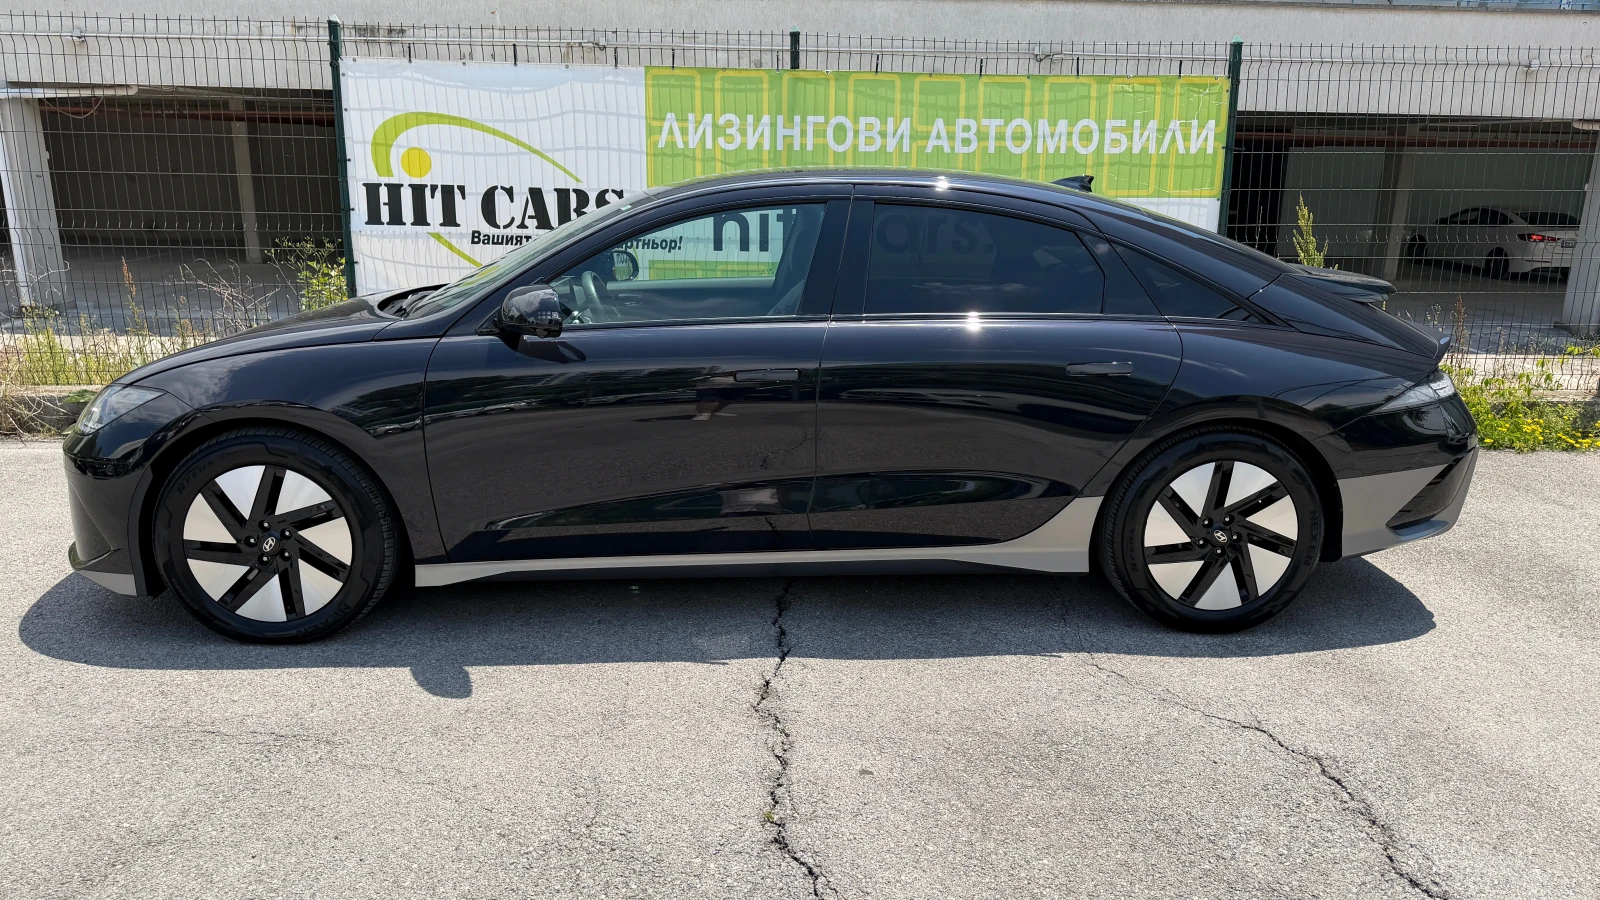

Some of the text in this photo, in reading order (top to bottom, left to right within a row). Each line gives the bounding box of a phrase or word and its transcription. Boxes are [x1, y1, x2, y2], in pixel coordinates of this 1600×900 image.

[657, 112, 1217, 156] ЛИЗИНГОВИ АВТОМОБИЛИ
[362, 181, 467, 228] HIT
[470, 229, 684, 254] Вашият ртньор!
